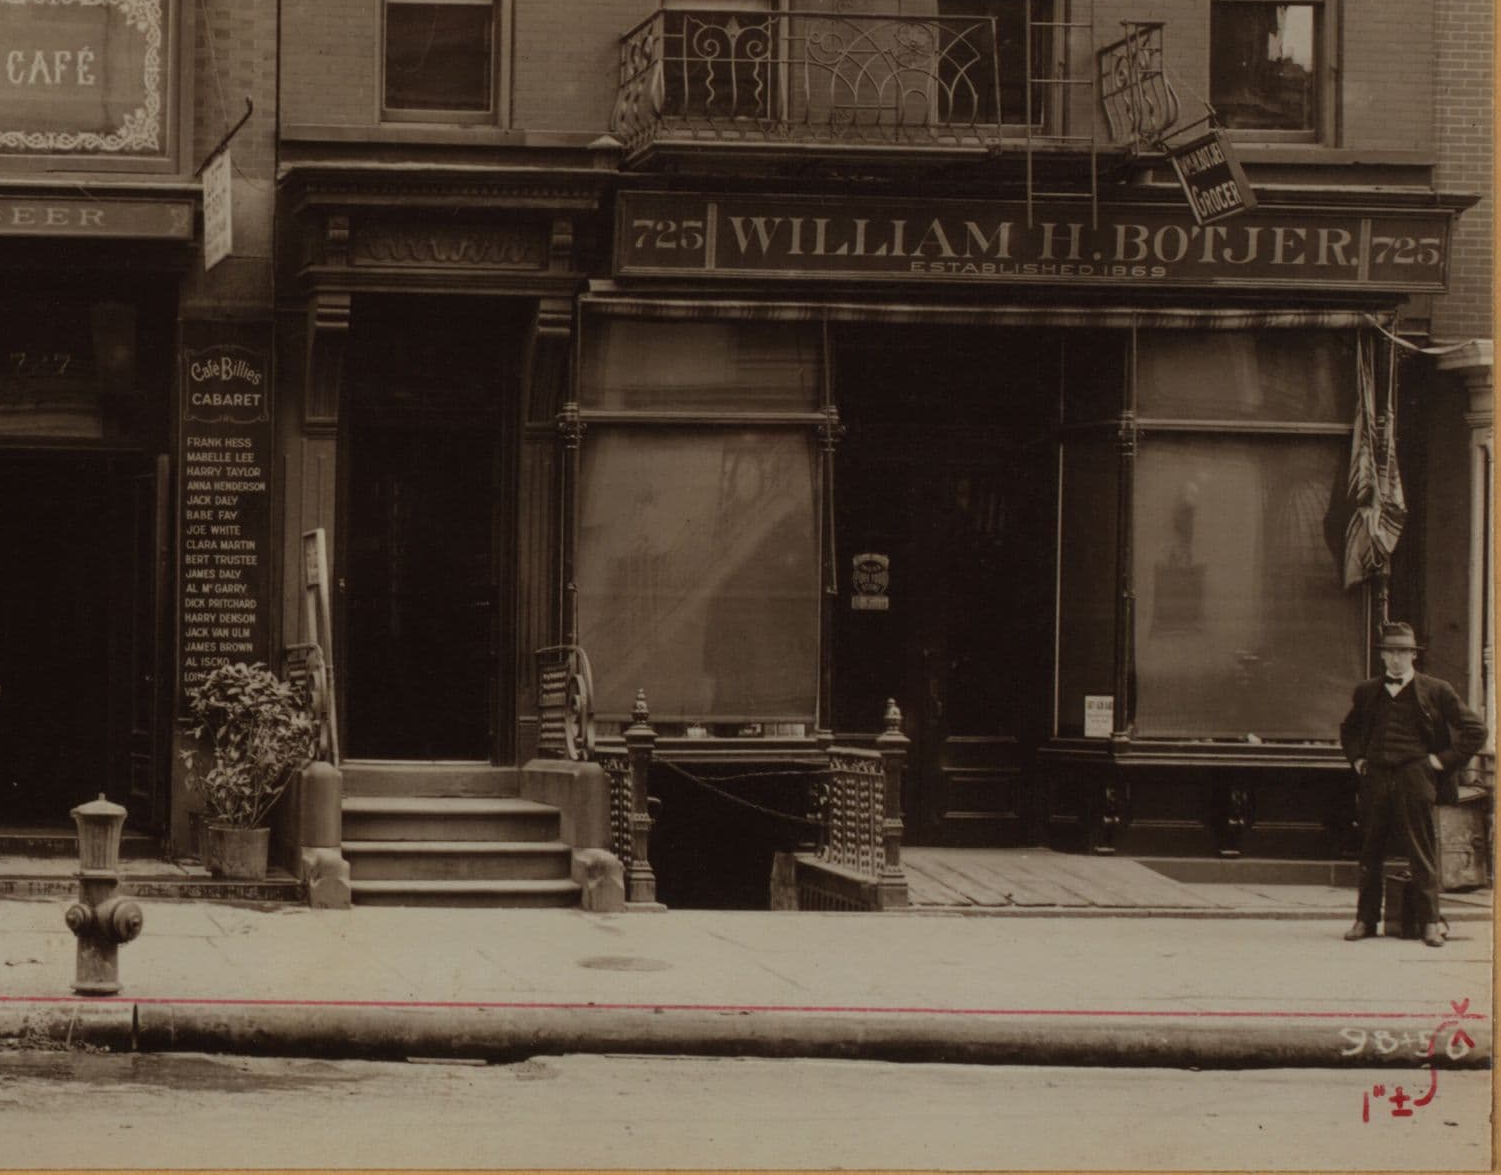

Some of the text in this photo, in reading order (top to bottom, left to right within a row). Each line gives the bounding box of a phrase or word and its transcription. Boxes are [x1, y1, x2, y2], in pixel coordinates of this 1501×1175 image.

[6, 45, 97, 88] CAFÉ
[1191, 180, 1243, 217] GROCER
[633, 219, 704, 250] 725
[727, 216, 1360, 267] WILLIAM H. BOTJER.
[910, 261, 1168, 278] ESTABLISHED 1869
[192, 392, 262, 406] CABARET
[187, 437, 222, 448] FRANK
[187, 452, 255, 463] MABELLE LEE
[187, 467, 261, 477] HARRY TAYLOR
[187, 481, 266, 492] ANNA HENDERSON
[187, 496, 239, 505] JACK DALY
[218, 510, 238, 521] FAY
[187, 525, 241, 536] JOE WHITE
[186, 540, 256, 550] CLARA MARTIN
[185, 554, 209, 565] BERT
[185, 569, 242, 579] JAMES DALY
[186, 584, 198, 594] AL
[184, 598, 257, 609] DICK PRITCHARD
[184, 614, 217, 624] HARRY
[185, 627, 209, 638] JACK
[185, 642, 253, 652] JAMES BROWN
[185, 656, 198, 667] AL
